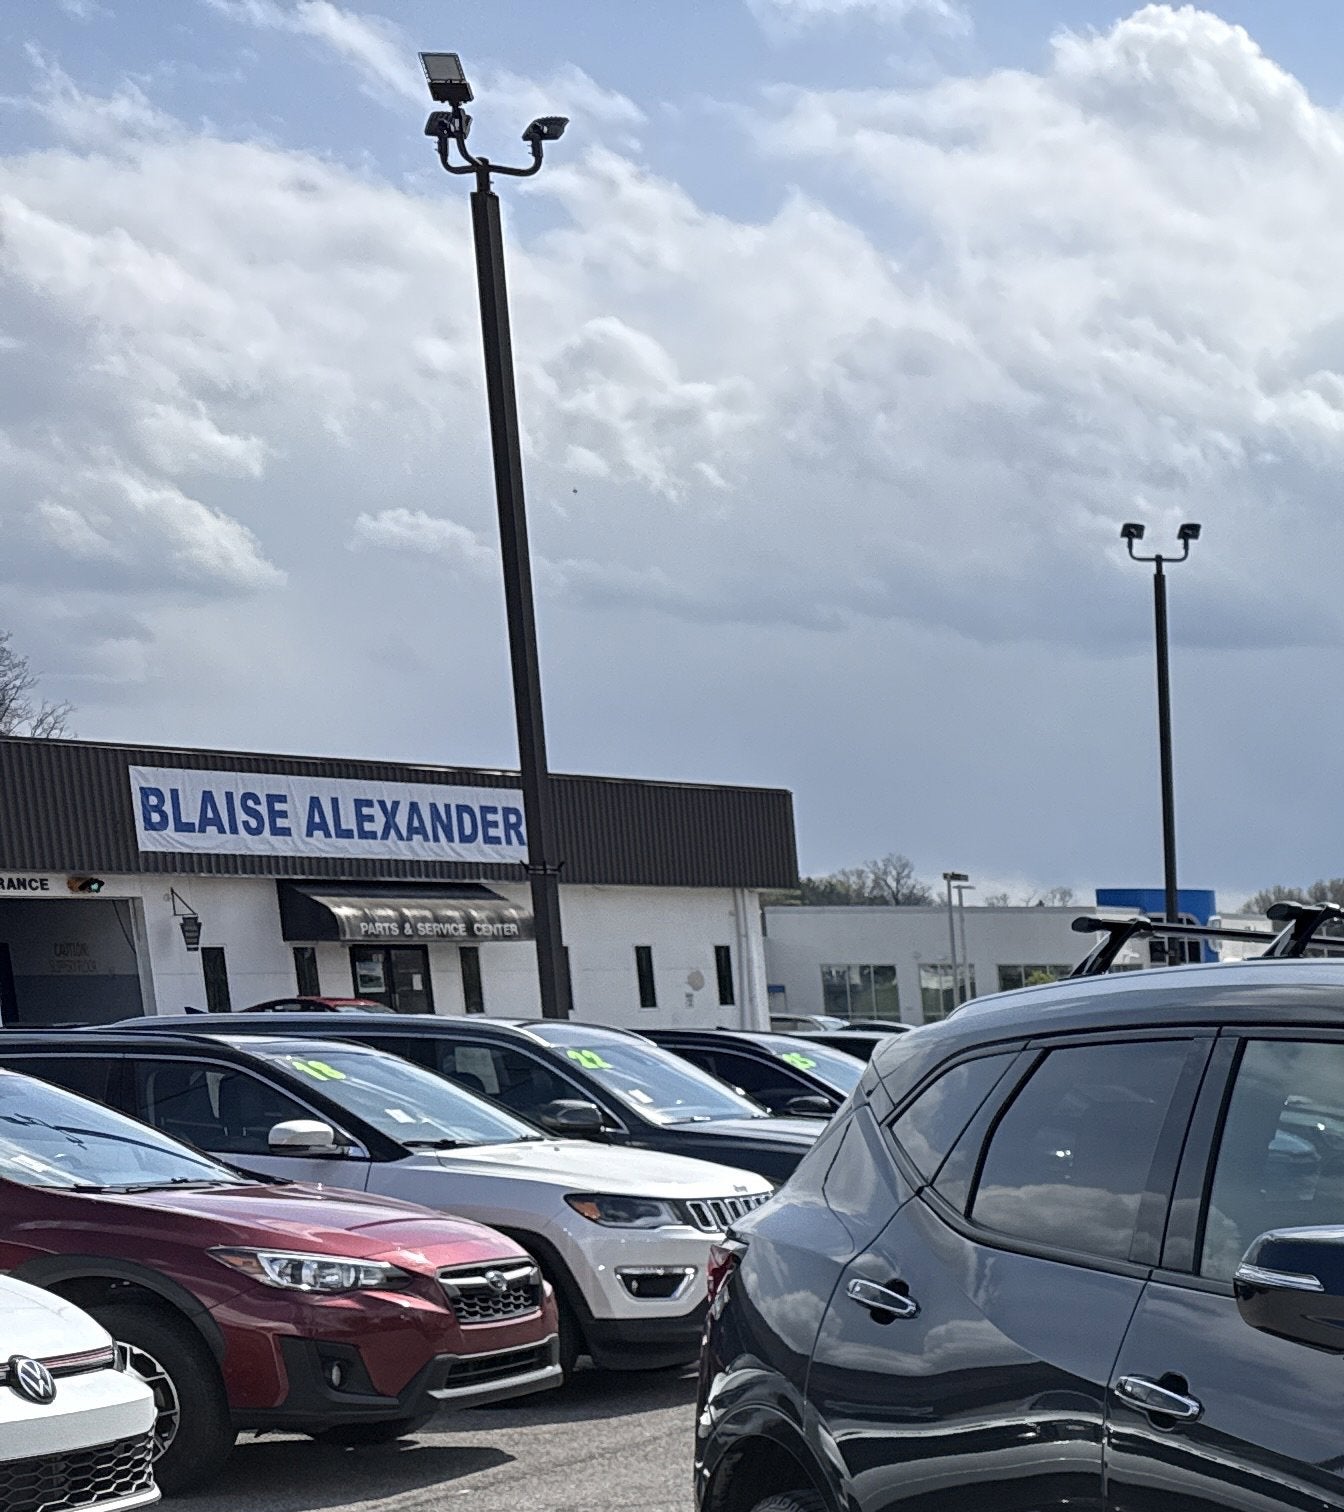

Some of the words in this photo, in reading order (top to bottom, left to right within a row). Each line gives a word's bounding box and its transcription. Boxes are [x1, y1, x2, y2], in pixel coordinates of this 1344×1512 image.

[139, 786, 292, 837] BLAISE
[305, 796, 527, 847] ALEXANDER
[360, 922, 399, 936] PARTS
[404, 923, 413, 935] &
[417, 922, 467, 937] SERVICE
[473, 923, 519, 936] CENTER
[567, 1050, 614, 1069] 22
